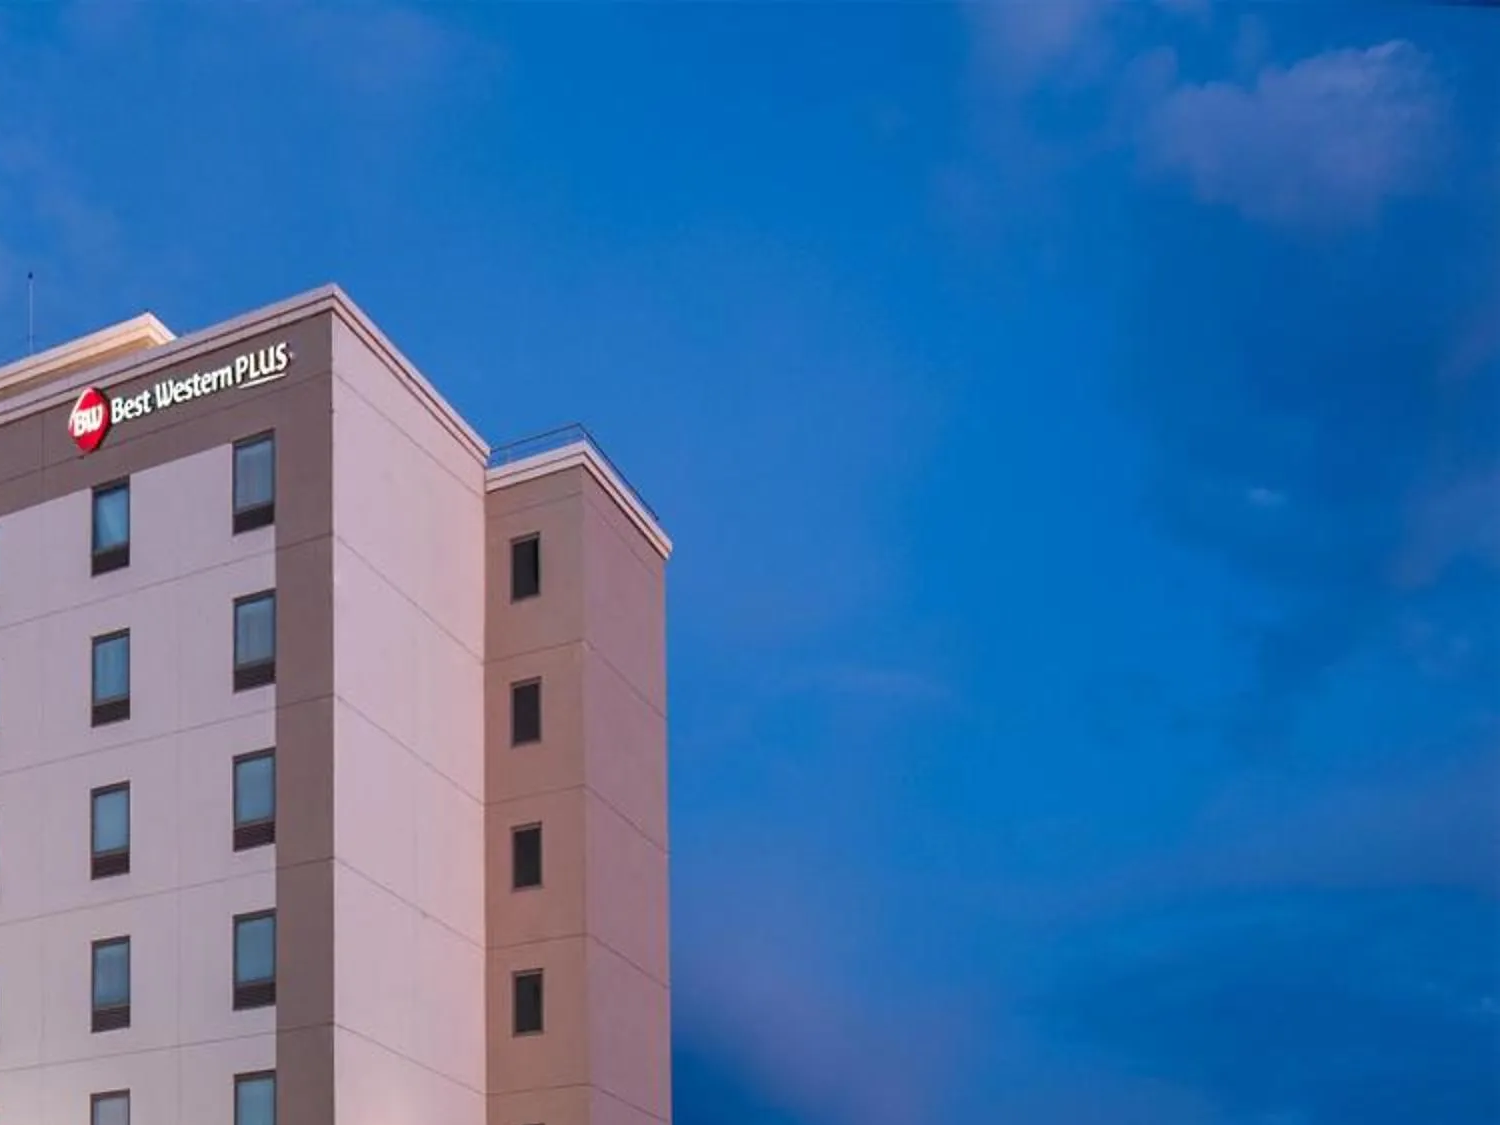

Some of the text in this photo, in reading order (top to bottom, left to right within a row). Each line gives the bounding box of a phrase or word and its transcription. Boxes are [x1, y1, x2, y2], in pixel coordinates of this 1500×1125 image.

[111, 342, 288, 424] Best Western PLUS
[73, 403, 104, 437] BW
